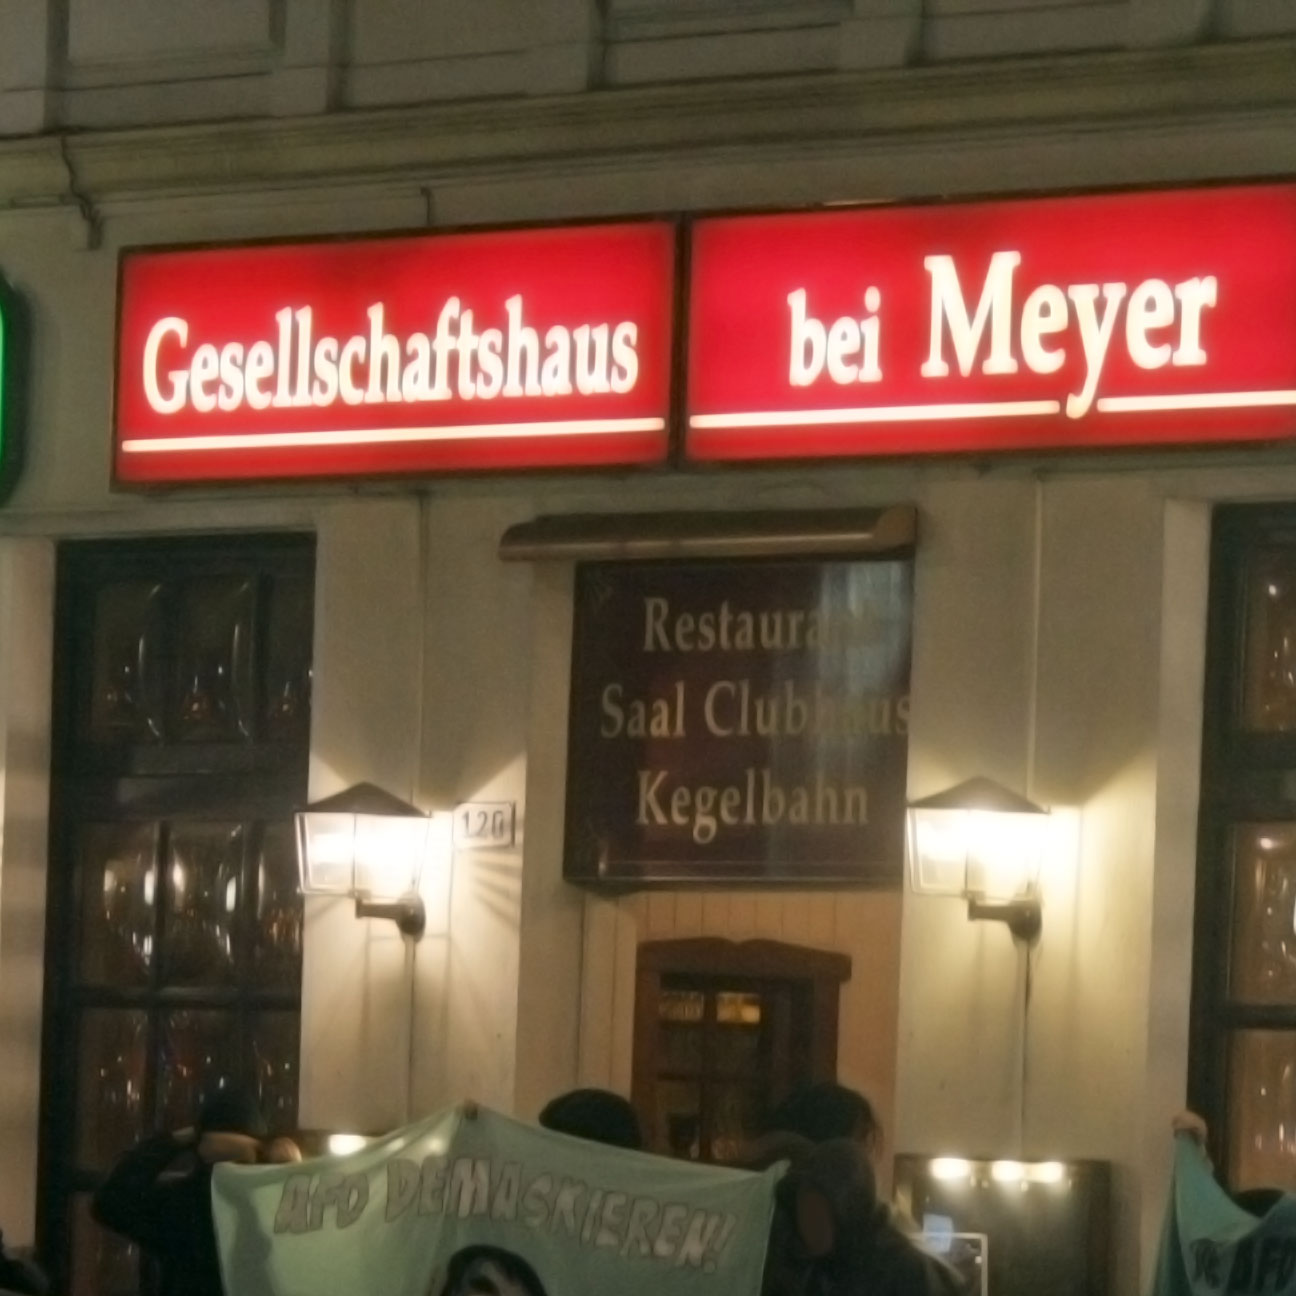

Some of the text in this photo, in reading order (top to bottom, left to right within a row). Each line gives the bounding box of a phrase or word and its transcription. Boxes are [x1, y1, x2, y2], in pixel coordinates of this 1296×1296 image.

[143, 250, 1218, 420] Gesellschaftshaus bei Meyer
[599, 679, 688, 740] Saal
[461, 809, 505, 840] 120
[634, 766, 870, 845] Kegelbahn
[385, 1155, 738, 1274] DEMASKIEREN!
